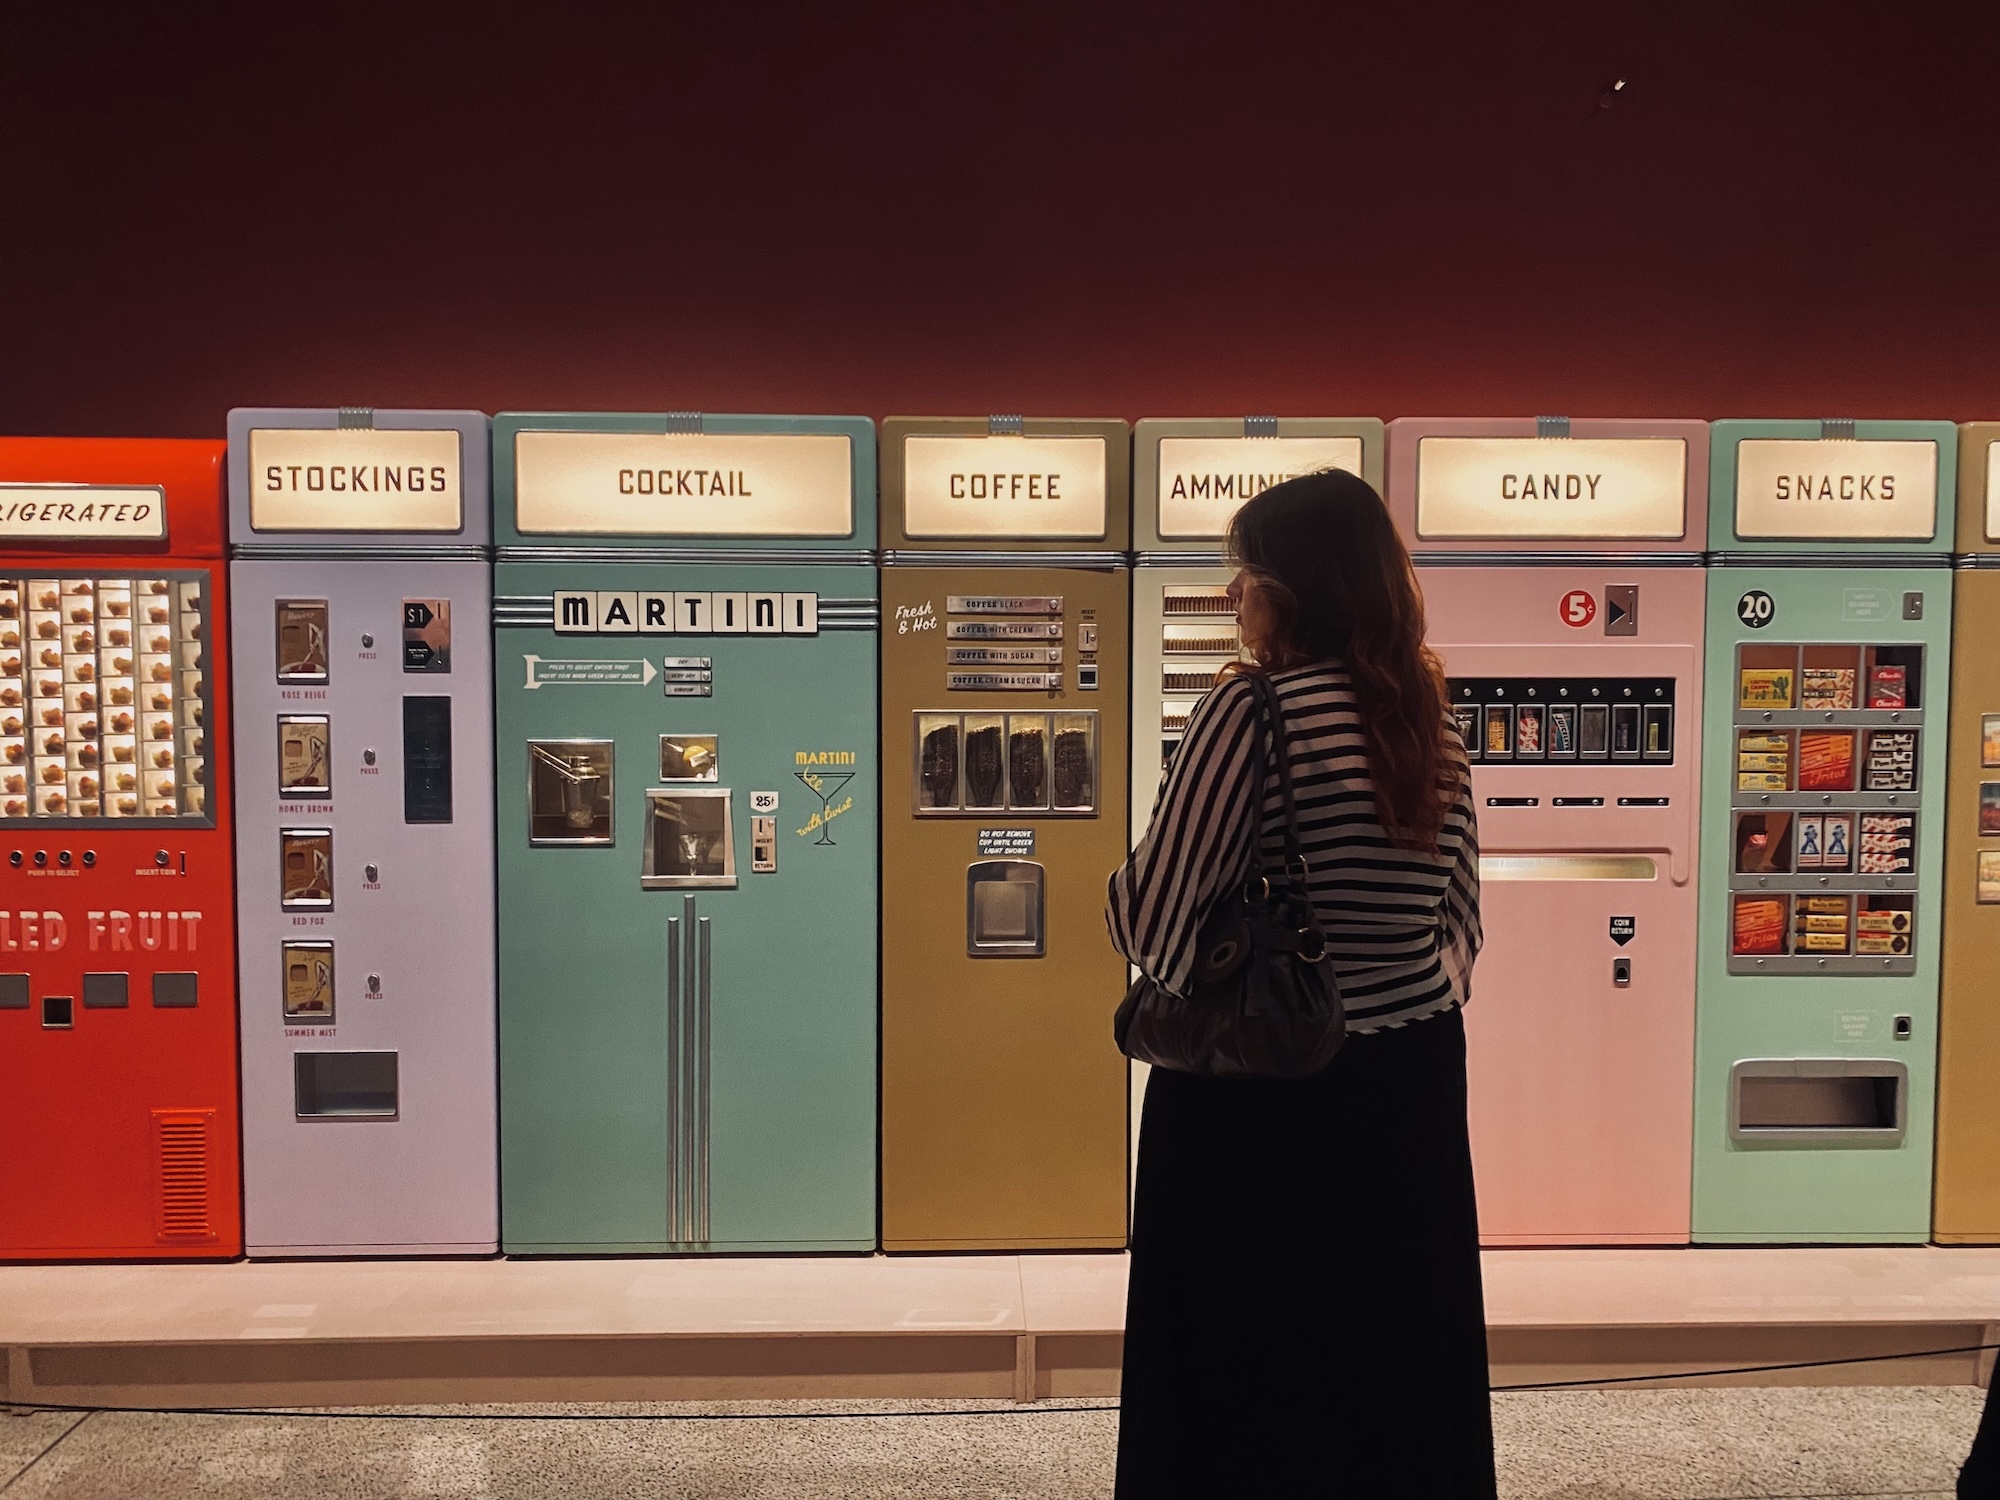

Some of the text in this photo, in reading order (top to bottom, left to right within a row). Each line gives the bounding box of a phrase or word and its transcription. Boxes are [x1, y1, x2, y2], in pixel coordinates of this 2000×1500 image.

[266, 465, 447, 492] STOCKINGS
[618, 469, 752, 497] COCKTAIL
[950, 474, 1061, 500] COFFEE
[1170, 474, 1298, 500] AMMUN
[1501, 474, 1603, 500] CANDY
[1776, 474, 1897, 500] SNACKS
[0, 503, 150, 522] IGERATED
[895, 600, 933, 620] Fresh
[966, 600, 997, 608] COFFEE
[1741, 594, 1772, 619] 20
[408, 608, 424, 623] $1
[897, 616, 937, 635] & Hot
[956, 626, 1034, 634] COFFEE WITH CREAM
[358, 652, 377, 660] PRESS
[956, 652, 987, 660] COFFEE
[1010, 652, 1035, 660] SUGAR
[953, 676, 983, 684] COFFEE
[985, 676, 1010, 684] CREAM
[1010, 676, 1016, 684] &
[281, 691, 326, 699] ROSE BEIGE
[1809, 769, 1846, 786] Fritos
[279, 805, 334, 813] HONEY BROWN
[796, 797, 853, 837] with twist
[979, 830, 1032, 838] DO NOT REMOVE
[983, 847, 1028, 855] LIGHT SHOWS
[56, 869, 80, 877] SELECT
[135, 868, 159, 876] INSERT
[292, 917, 325, 925] RED FOX
[1613, 919, 1630, 927] COIN
[87, 910, 202, 951] FRUIT
[1742, 932, 1778, 949] Fritos
[285, 1029, 337, 1037] SUMMER MIST
